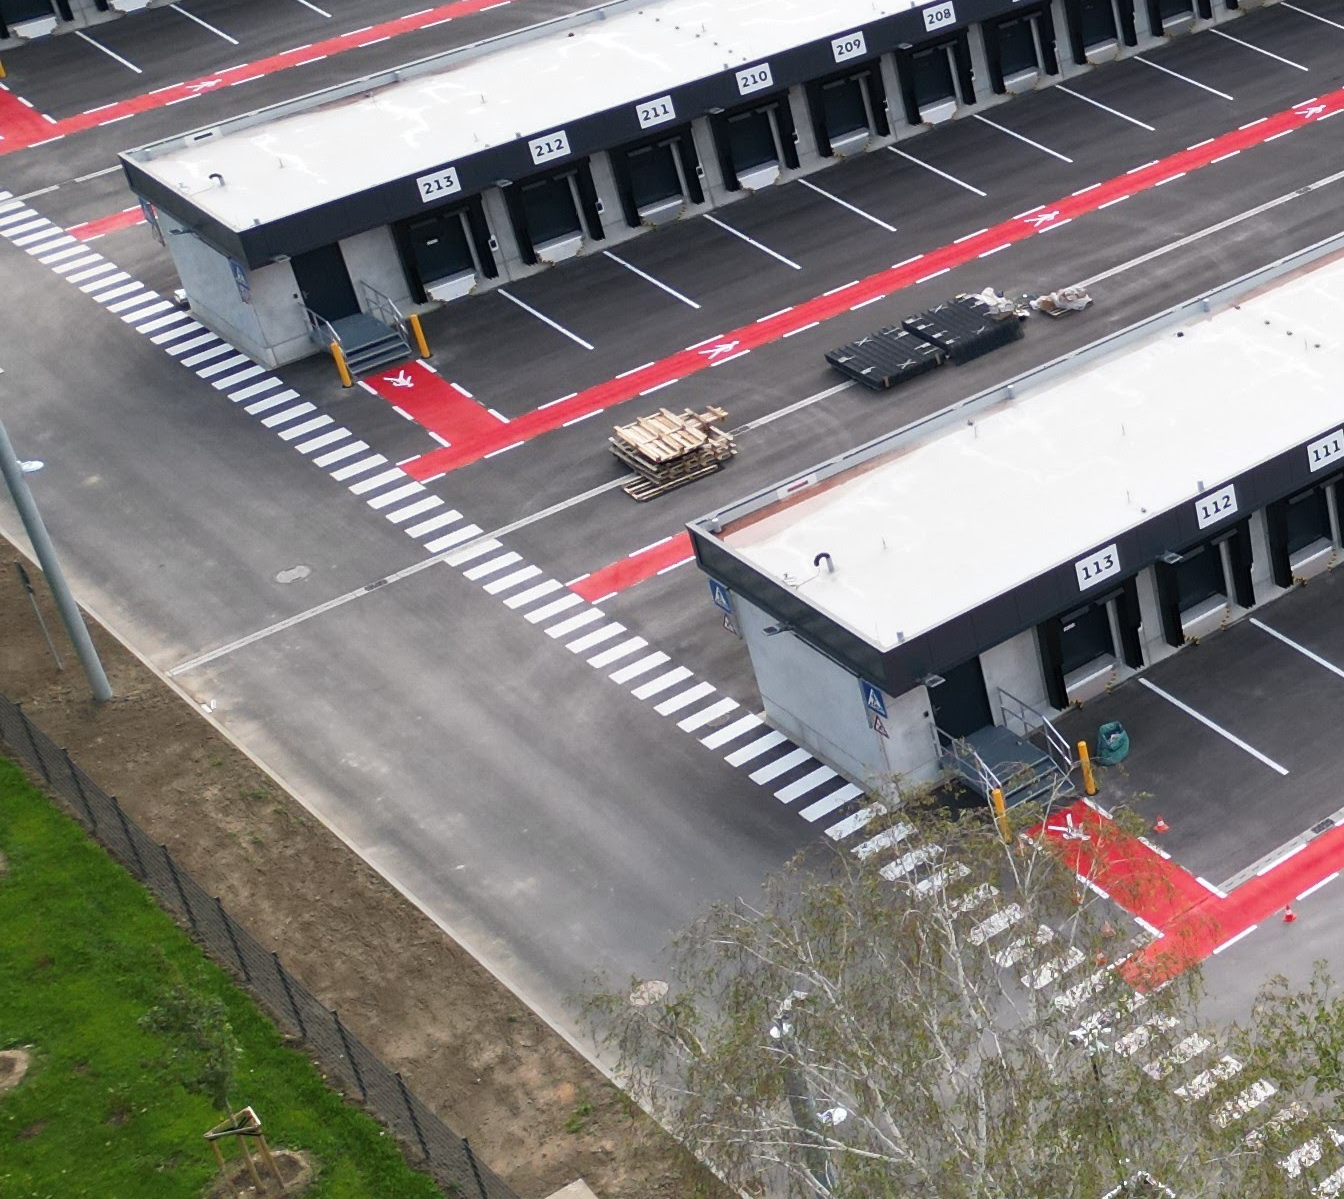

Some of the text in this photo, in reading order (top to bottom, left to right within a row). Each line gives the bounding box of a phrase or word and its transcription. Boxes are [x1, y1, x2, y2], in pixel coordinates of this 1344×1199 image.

[927, 8, 952, 25] 208
[836, 38, 861, 56] 209
[740, 70, 768, 88] 210
[641, 103, 670, 122] 211
[534, 138, 565, 157] 212
[422, 175, 454, 195] 213
[1313, 439, 1341, 463] 111
[1201, 494, 1232, 520] 112
[1082, 553, 1114, 581] 113
